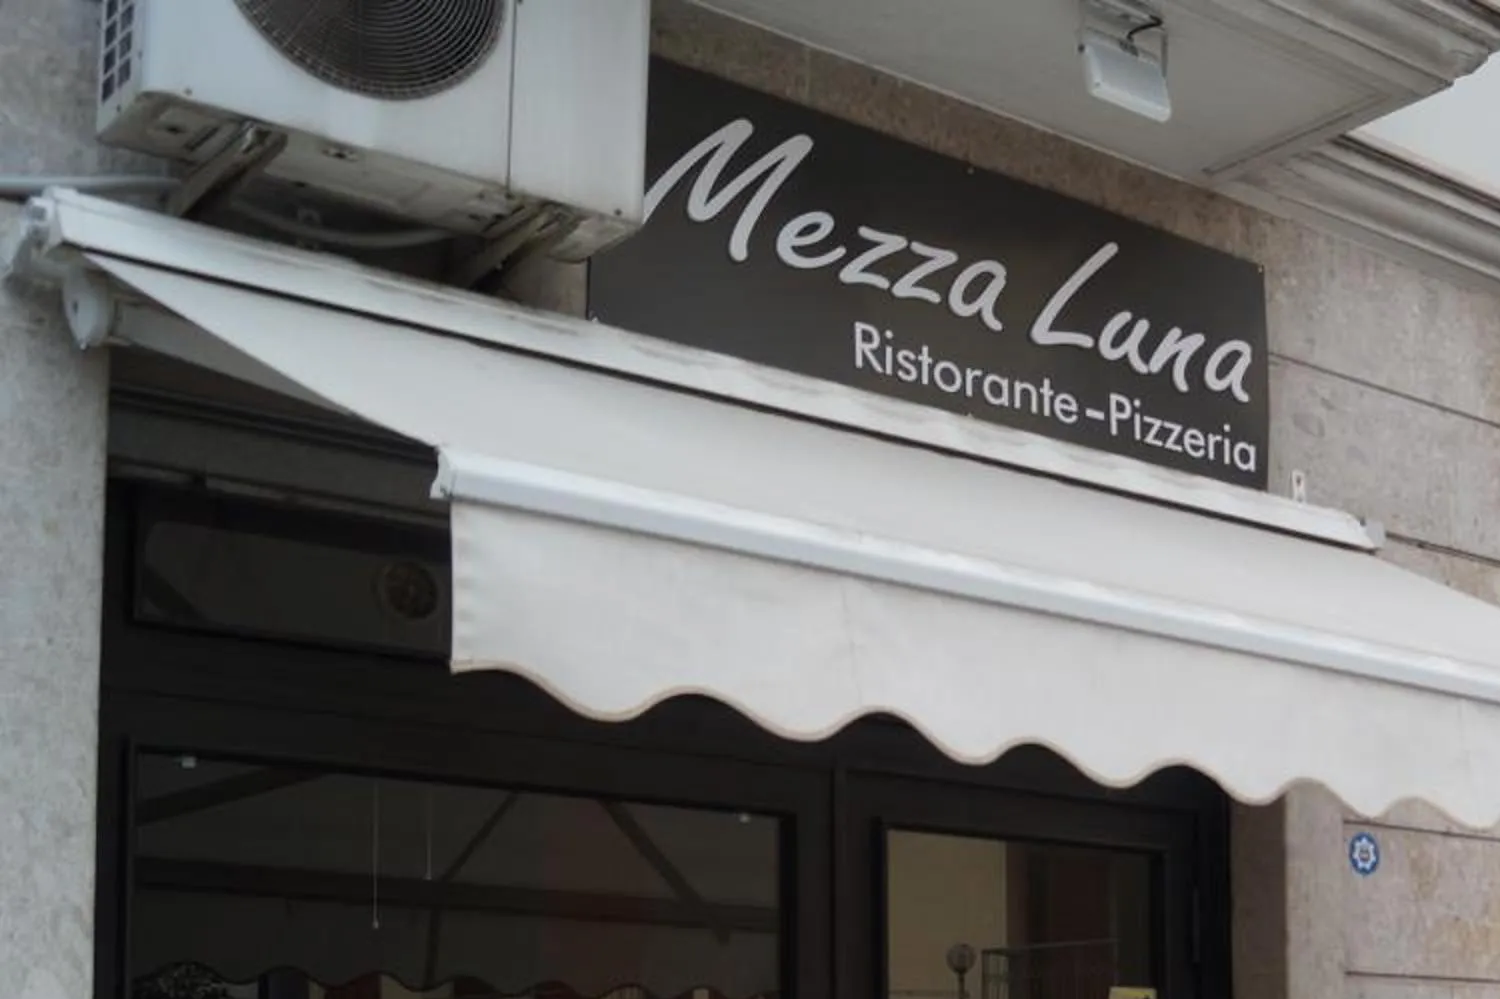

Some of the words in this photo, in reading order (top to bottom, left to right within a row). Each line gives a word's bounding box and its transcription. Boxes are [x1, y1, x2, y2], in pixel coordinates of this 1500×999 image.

[642, 118, 1007, 331] Mezza
[1029, 241, 1251, 402] Luna
[853, 321, 1257, 472] Ristorante-Pizzeria
